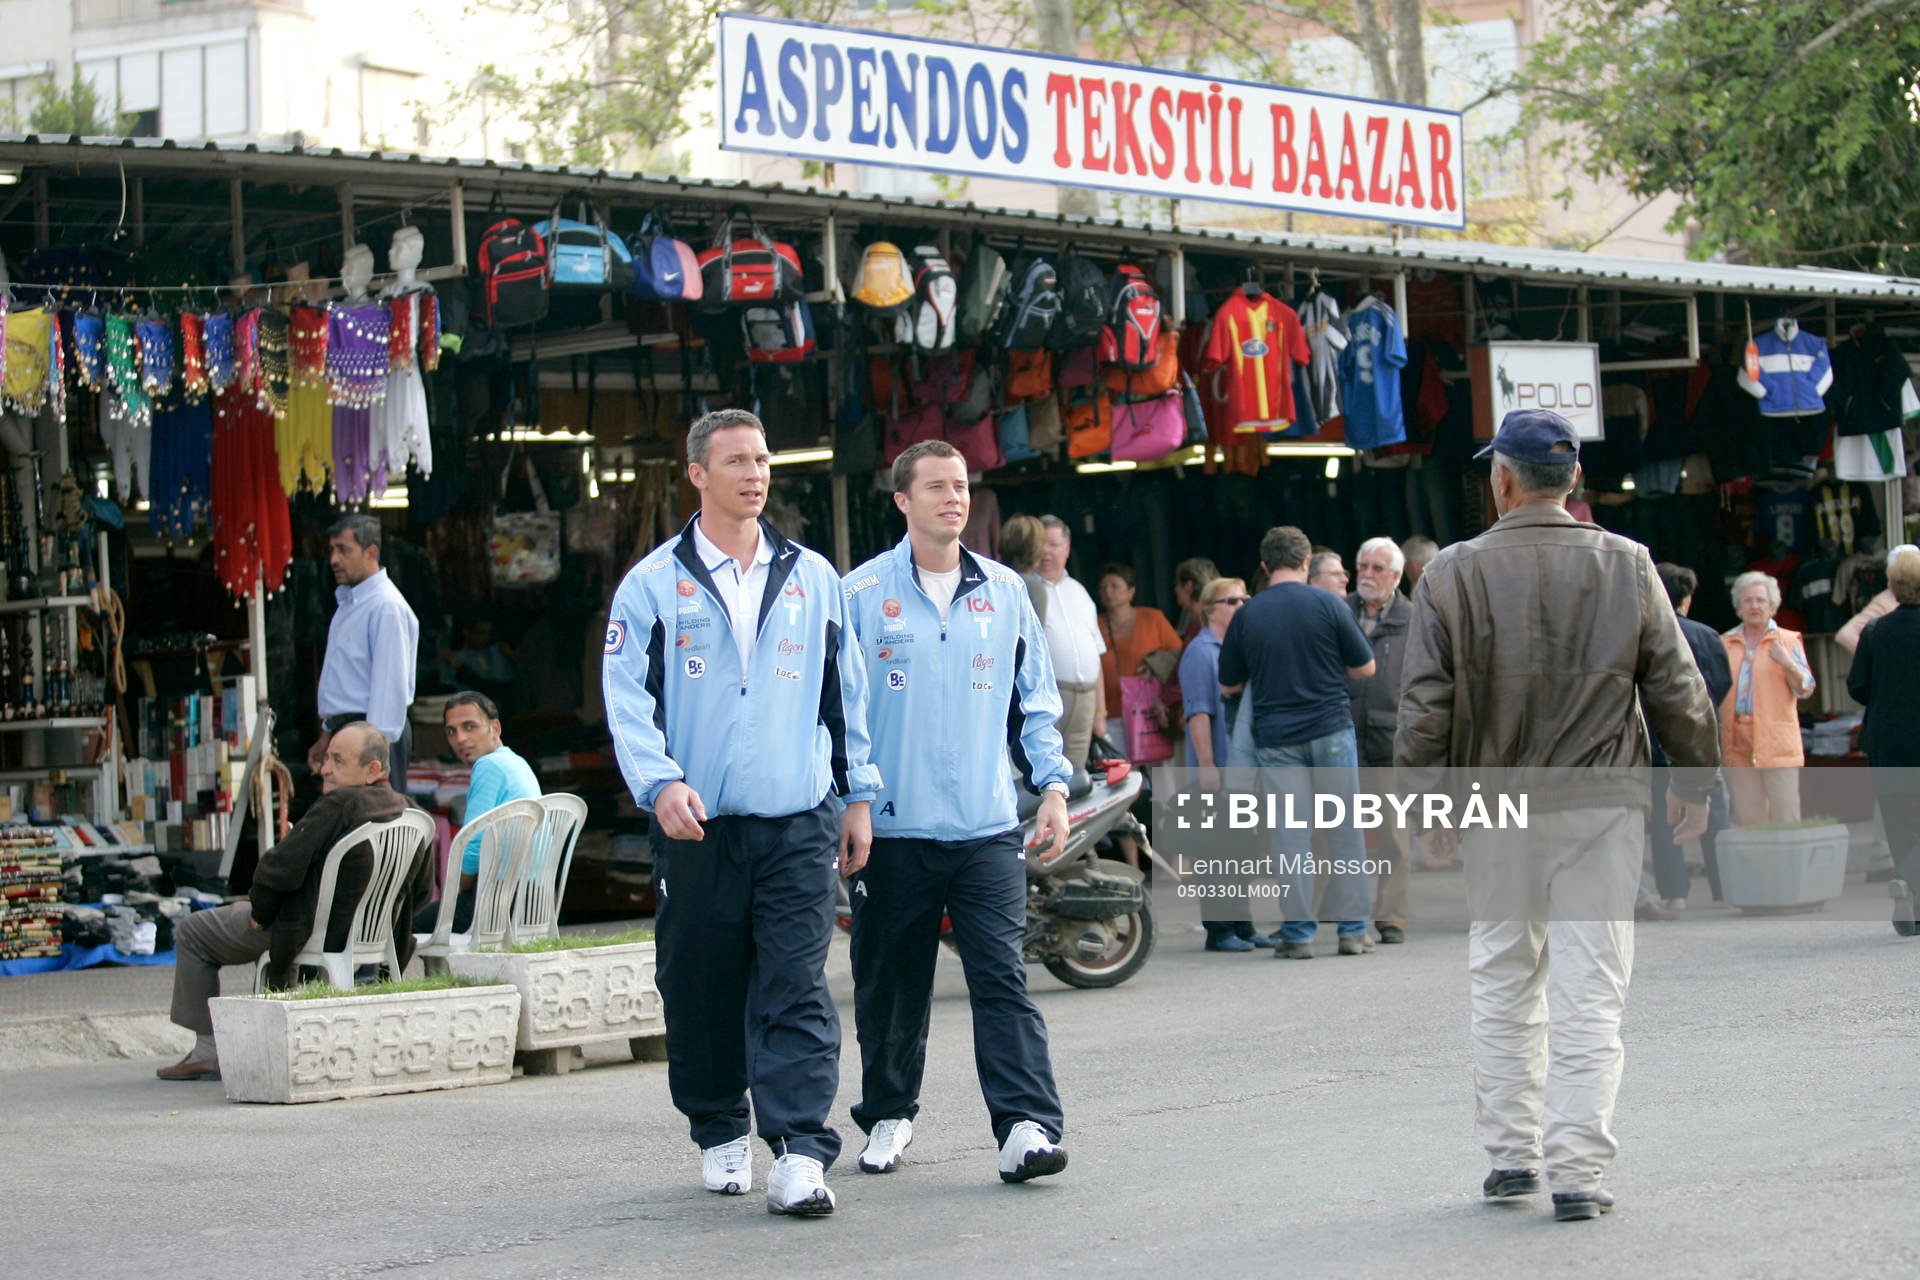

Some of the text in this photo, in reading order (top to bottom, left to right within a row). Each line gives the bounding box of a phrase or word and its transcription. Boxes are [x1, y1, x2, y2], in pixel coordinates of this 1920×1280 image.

[735, 33, 1457, 212] ASPENDOS TEKSTİL BAAZAR
[1517, 383, 1594, 409] POLO
[845, 575, 880, 600] STADIUM
[966, 597, 995, 613] ICA
